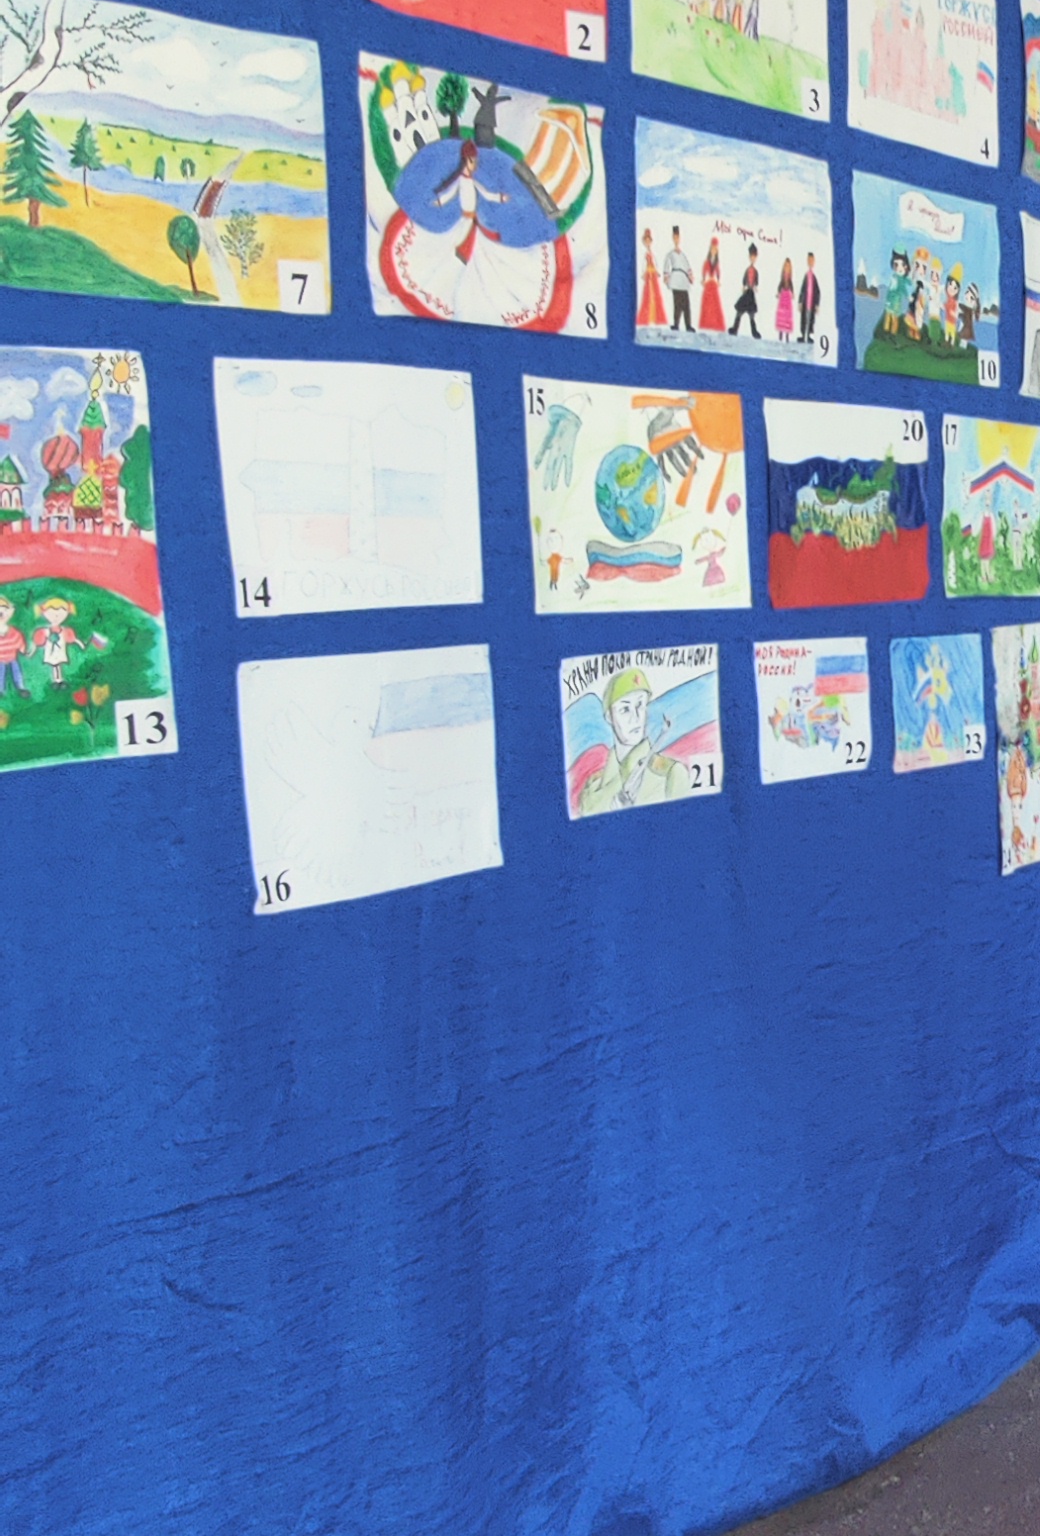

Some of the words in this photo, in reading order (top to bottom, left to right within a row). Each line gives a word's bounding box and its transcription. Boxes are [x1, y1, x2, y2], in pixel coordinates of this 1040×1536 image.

[577, 22, 592, 53] 2
[808, 88, 820, 112] 3
[980, 137, 990, 159] 4
[289, 272, 311, 306] 7
[584, 301, 599, 331] 8
[819, 335, 829, 358] 9
[980, 359, 997, 382] 10
[525, 388, 546, 417] 15
[902, 419, 923, 443] 20
[944, 424, 958, 446] 17
[239, 576, 272, 608] 14
[635, 648, 666, 666] СТРАНЫ
[122, 710, 168, 745] 13
[845, 741, 867, 765] 22
[965, 732, 982, 755] 23
[691, 763, 715, 789] 21
[261, 869, 291, 906] 16
